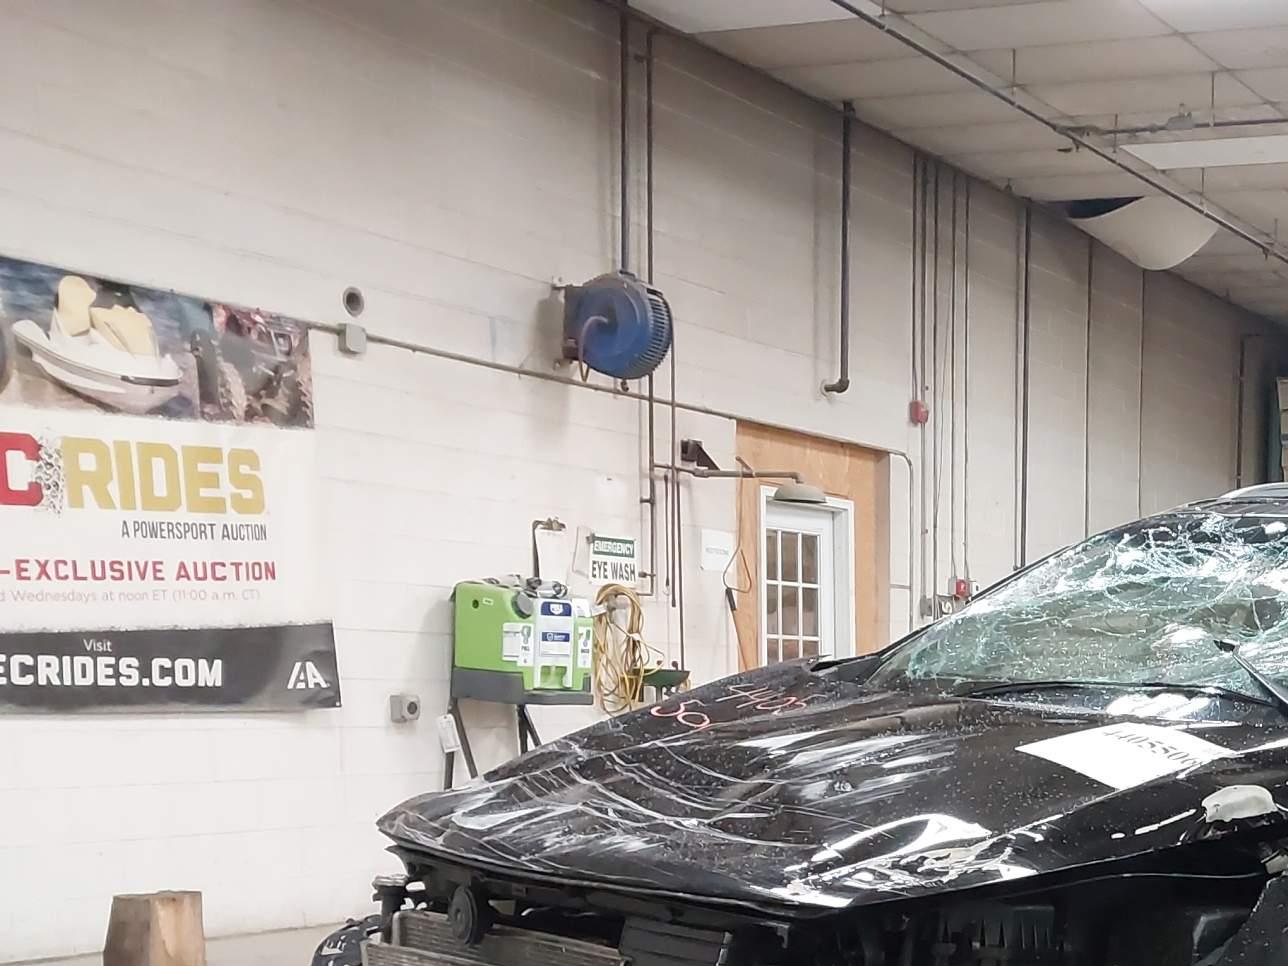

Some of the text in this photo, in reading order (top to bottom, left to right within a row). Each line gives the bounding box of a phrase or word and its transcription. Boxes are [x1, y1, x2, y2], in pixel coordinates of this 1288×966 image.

[60, 436, 266, 515] RIDES
[121, 520, 267, 542] A POWERSPORT AUCTION
[593, 540, 634, 557] EMERGENCY
[175, 561, 277, 582] AUCTION
[591, 560, 636, 583] EYE WASH
[11, 589, 96, 603] Wednesdays
[104, 589, 114, 601] at
[118, 591, 148, 601] noon
[153, 589, 168, 601] ET
[83, 639, 113, 652] Visit
